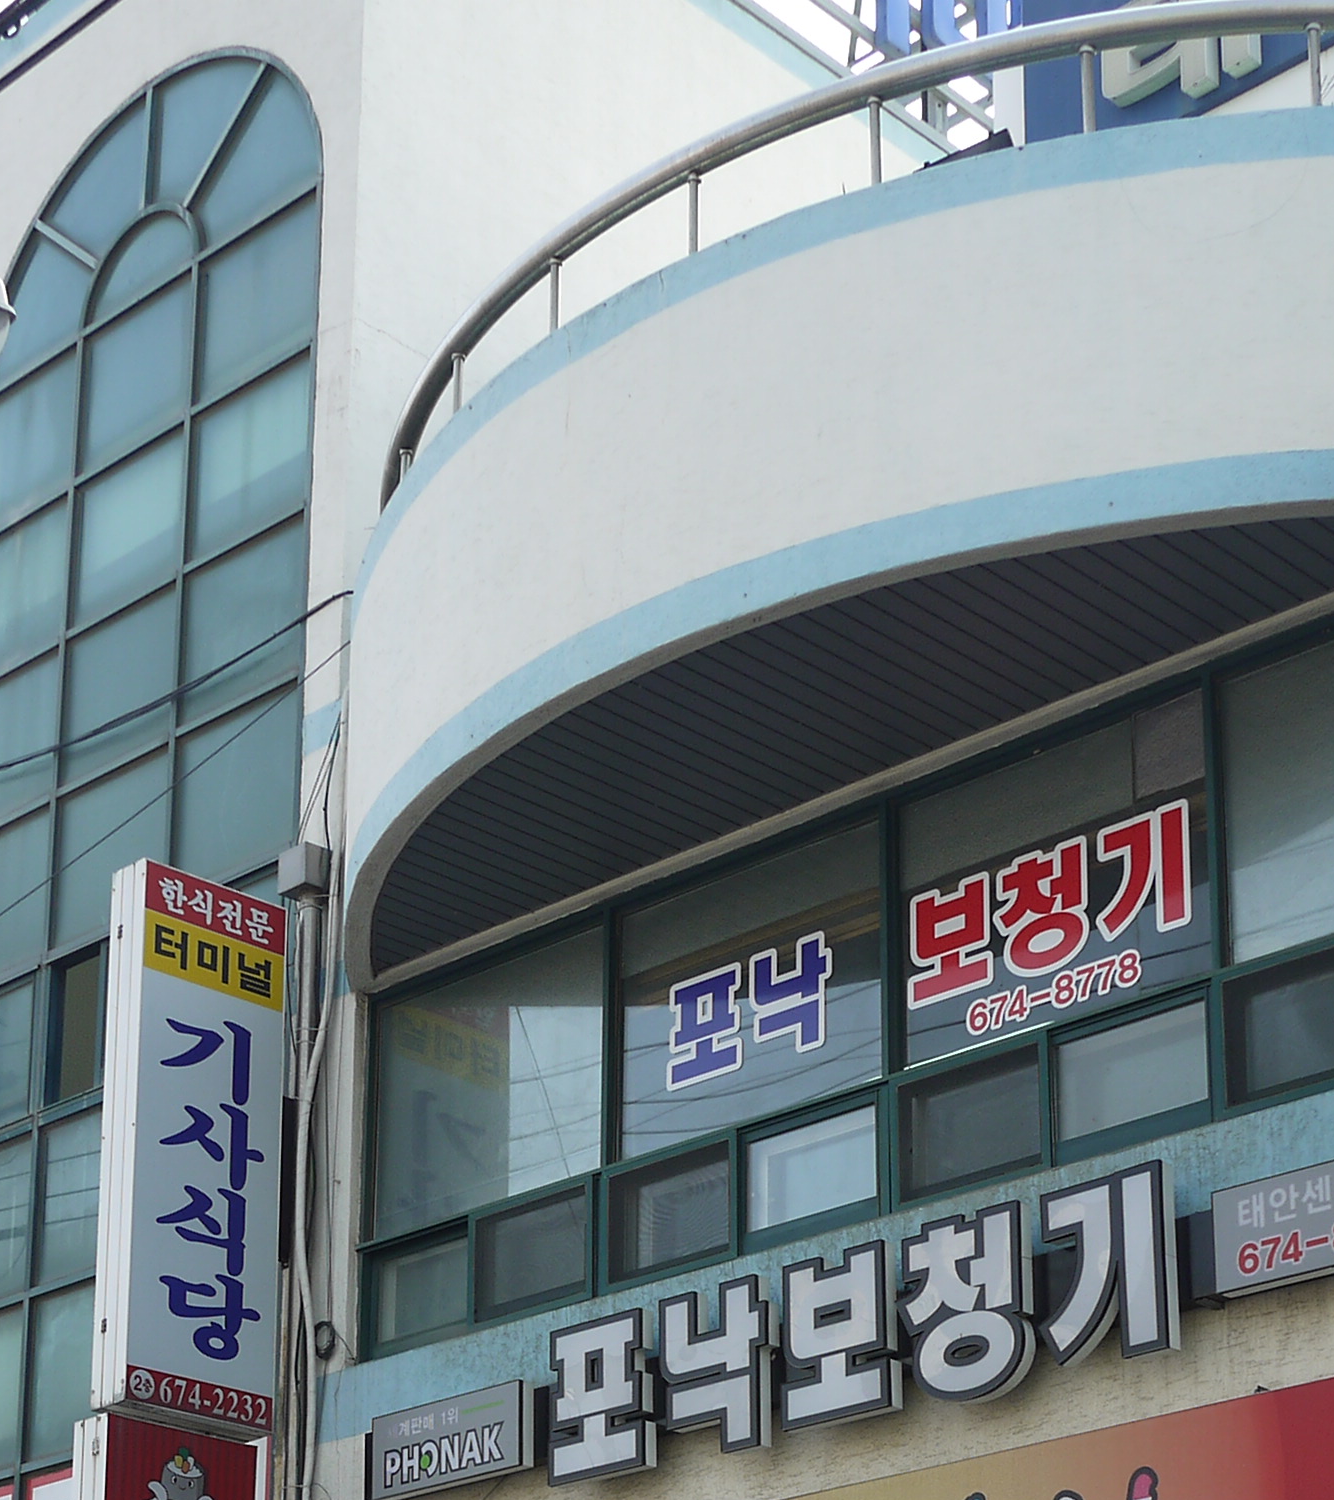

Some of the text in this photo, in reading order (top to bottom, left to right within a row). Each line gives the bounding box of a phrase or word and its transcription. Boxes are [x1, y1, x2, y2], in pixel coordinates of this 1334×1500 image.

[157, 874, 274, 946] 한식전문
[907, 797, 1193, 1012] 보청기
[153, 922, 273, 999] 터미널
[965, 947, 1143, 1037] 674-8778
[666, 930, 835, 1093] 포낙
[156, 1017, 266, 1362] 기사식당
[549, 1158, 1187, 1490] 포낙보청기
[158, 1374, 268, 1427] 674-2232
[381, 1430, 505, 1492] PHONAK
